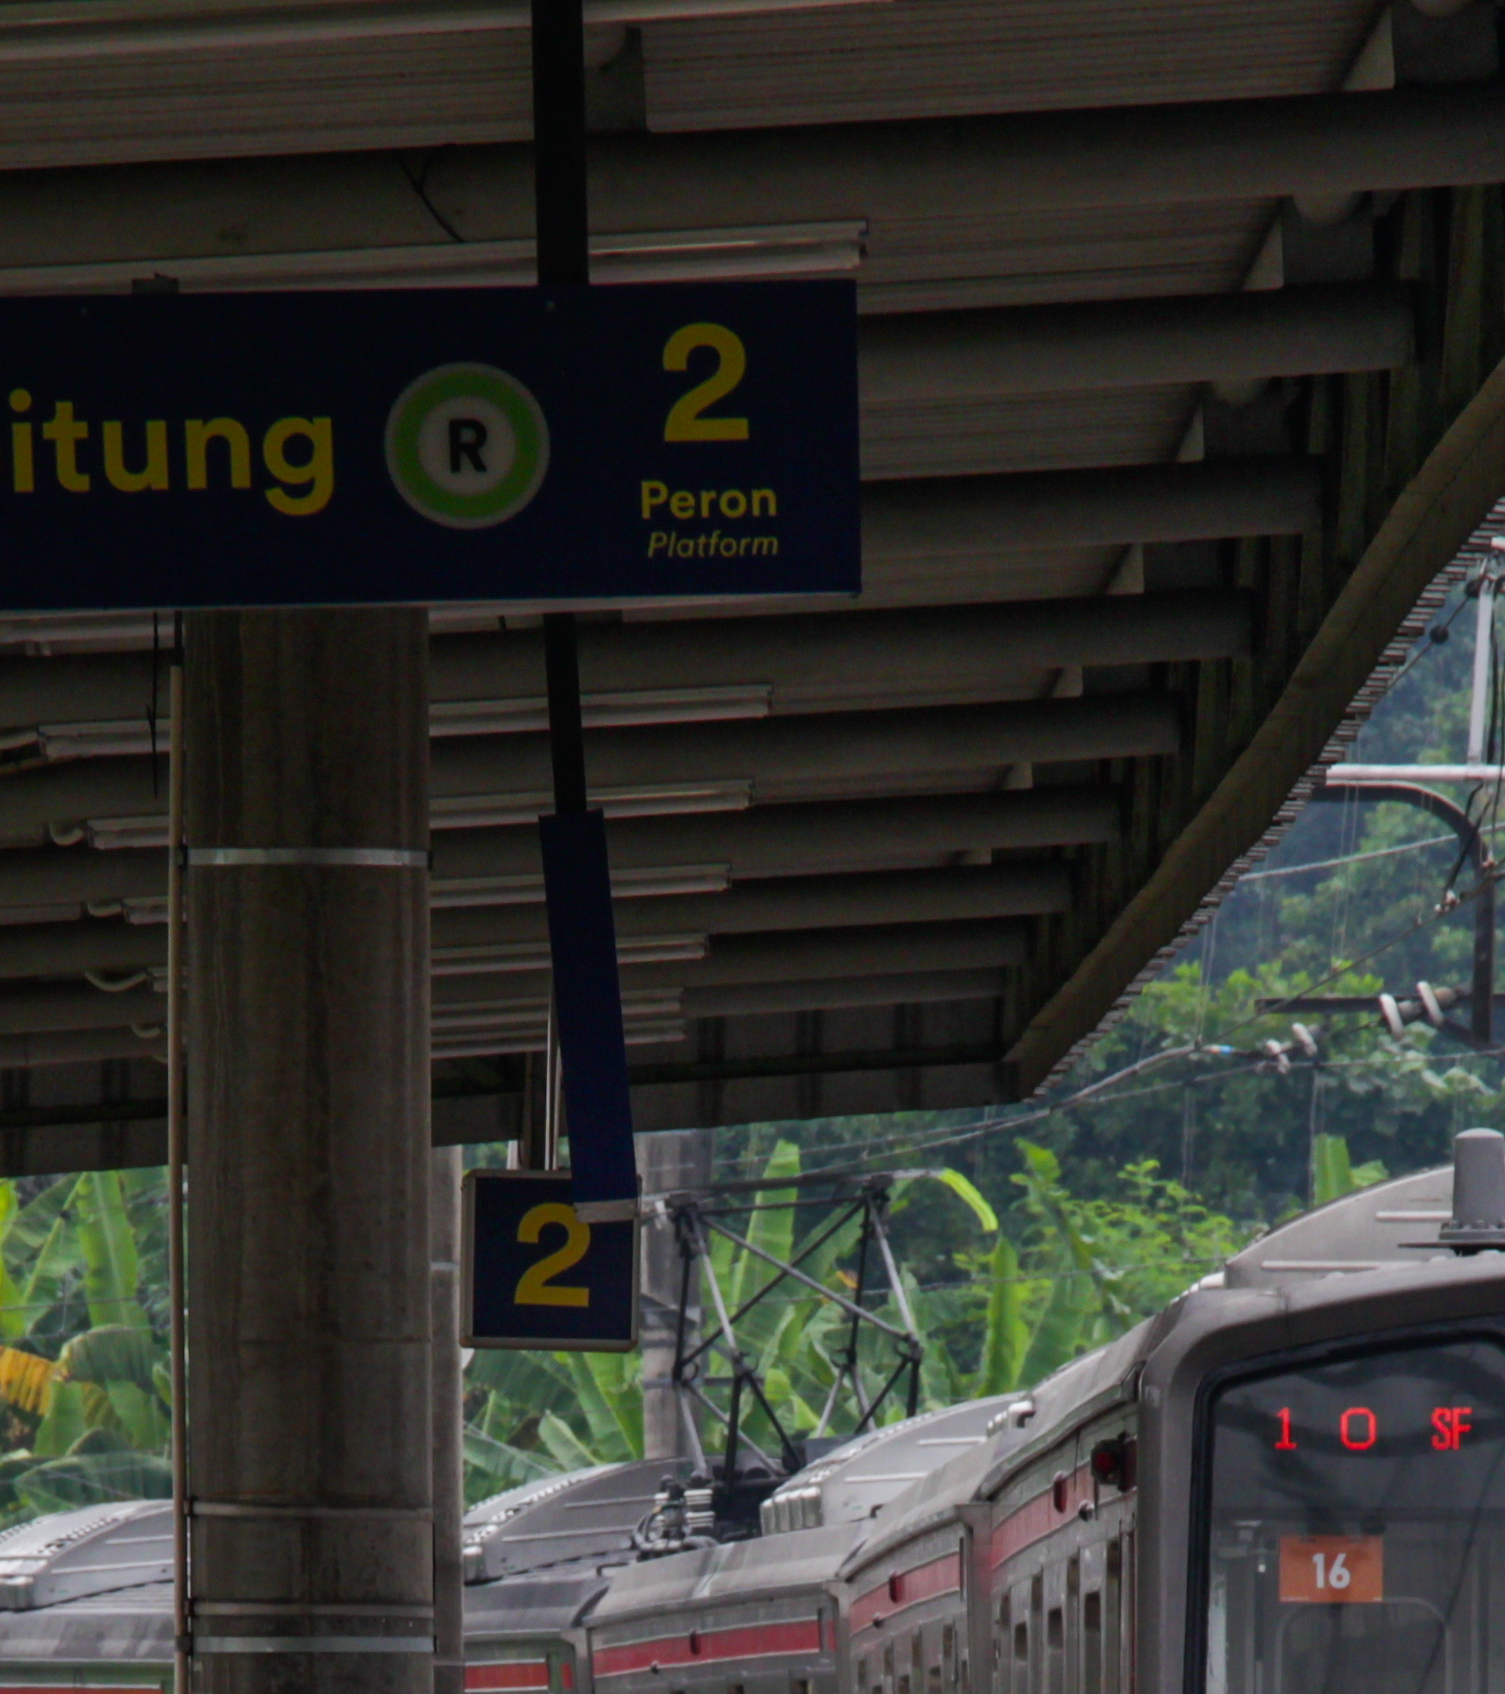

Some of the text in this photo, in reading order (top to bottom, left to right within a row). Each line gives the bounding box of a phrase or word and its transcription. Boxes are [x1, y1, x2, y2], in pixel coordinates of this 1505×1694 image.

[662, 321, 750, 442] 2
[447, 418, 488, 473] R
[640, 480, 778, 520] Peron
[647, 530, 778, 558] Platform
[514, 1202, 591, 1307] 2
[1312, 1552, 1351, 1589] 16
